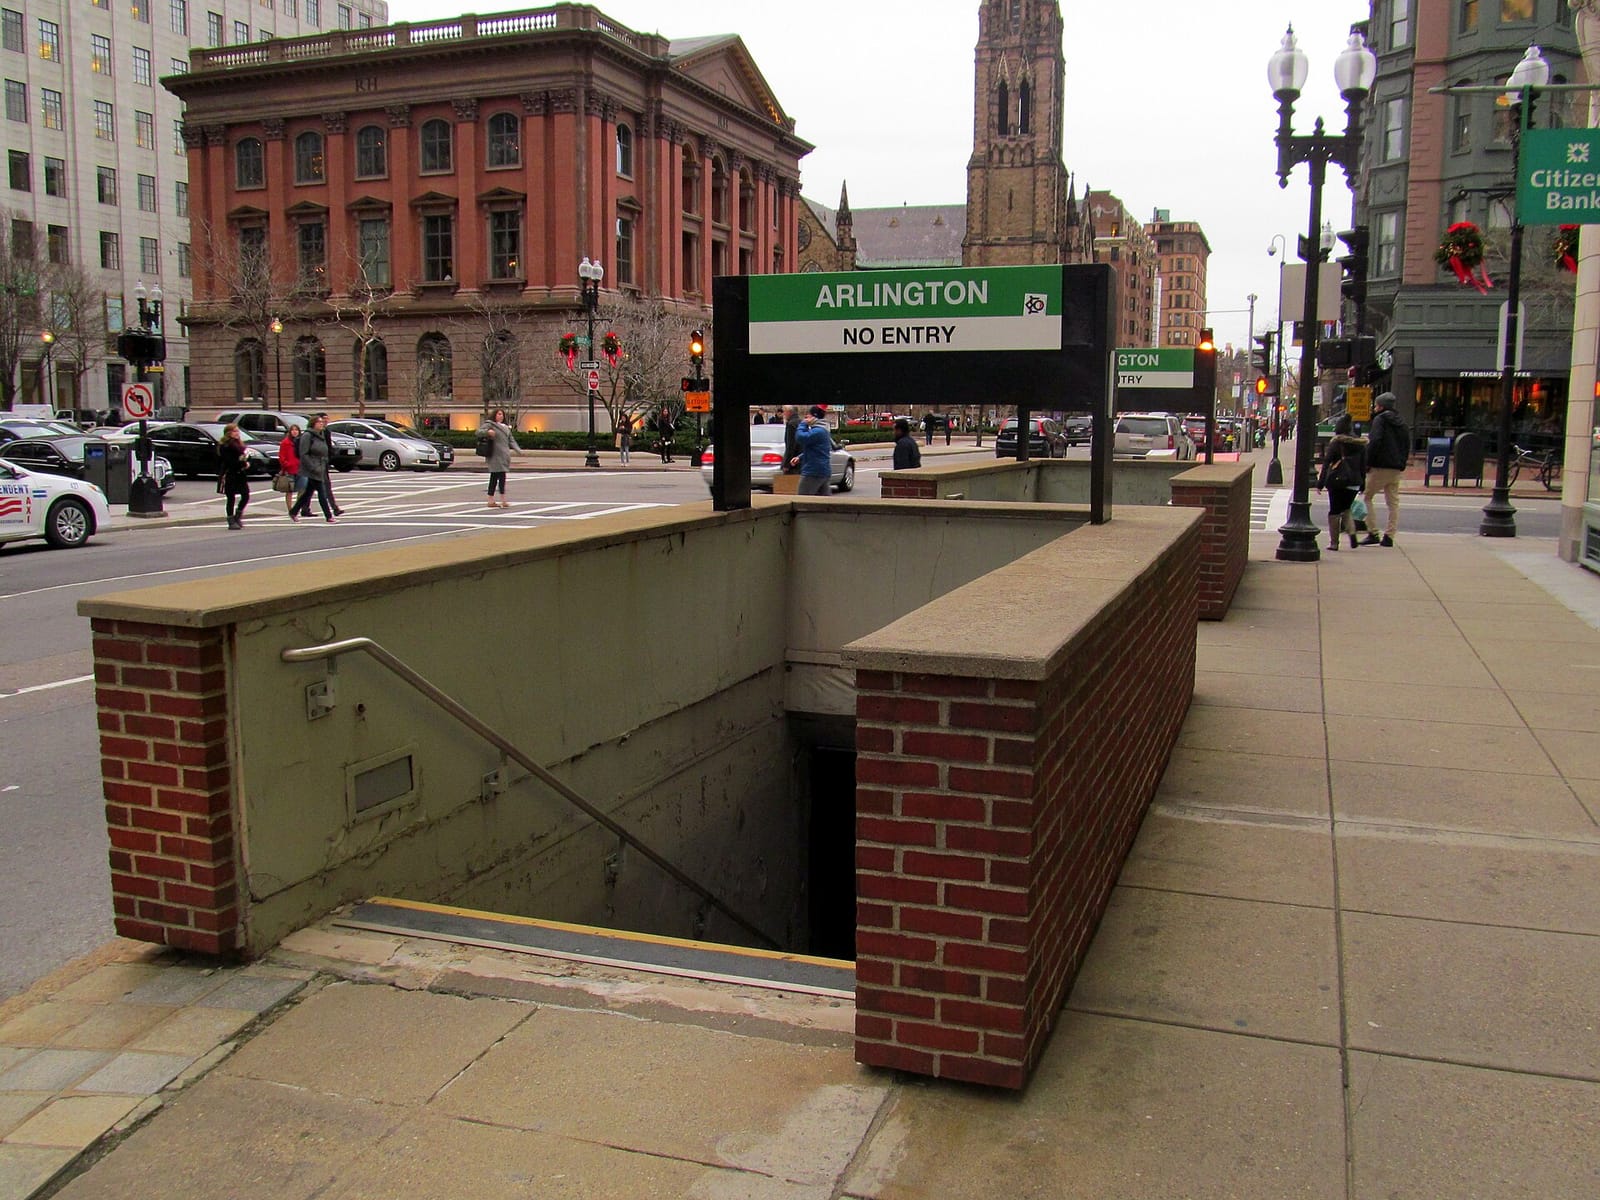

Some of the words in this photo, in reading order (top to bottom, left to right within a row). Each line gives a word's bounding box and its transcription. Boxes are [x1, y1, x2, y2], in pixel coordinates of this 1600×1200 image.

[1546, 190, 1600, 209] Bank
[815, 279, 988, 308] ARLINGTON
[843, 327, 875, 345] NO
[882, 325, 956, 345] ENTRY
[1118, 354, 1159, 366] GTON
[1118, 375, 1143, 384] TRY
